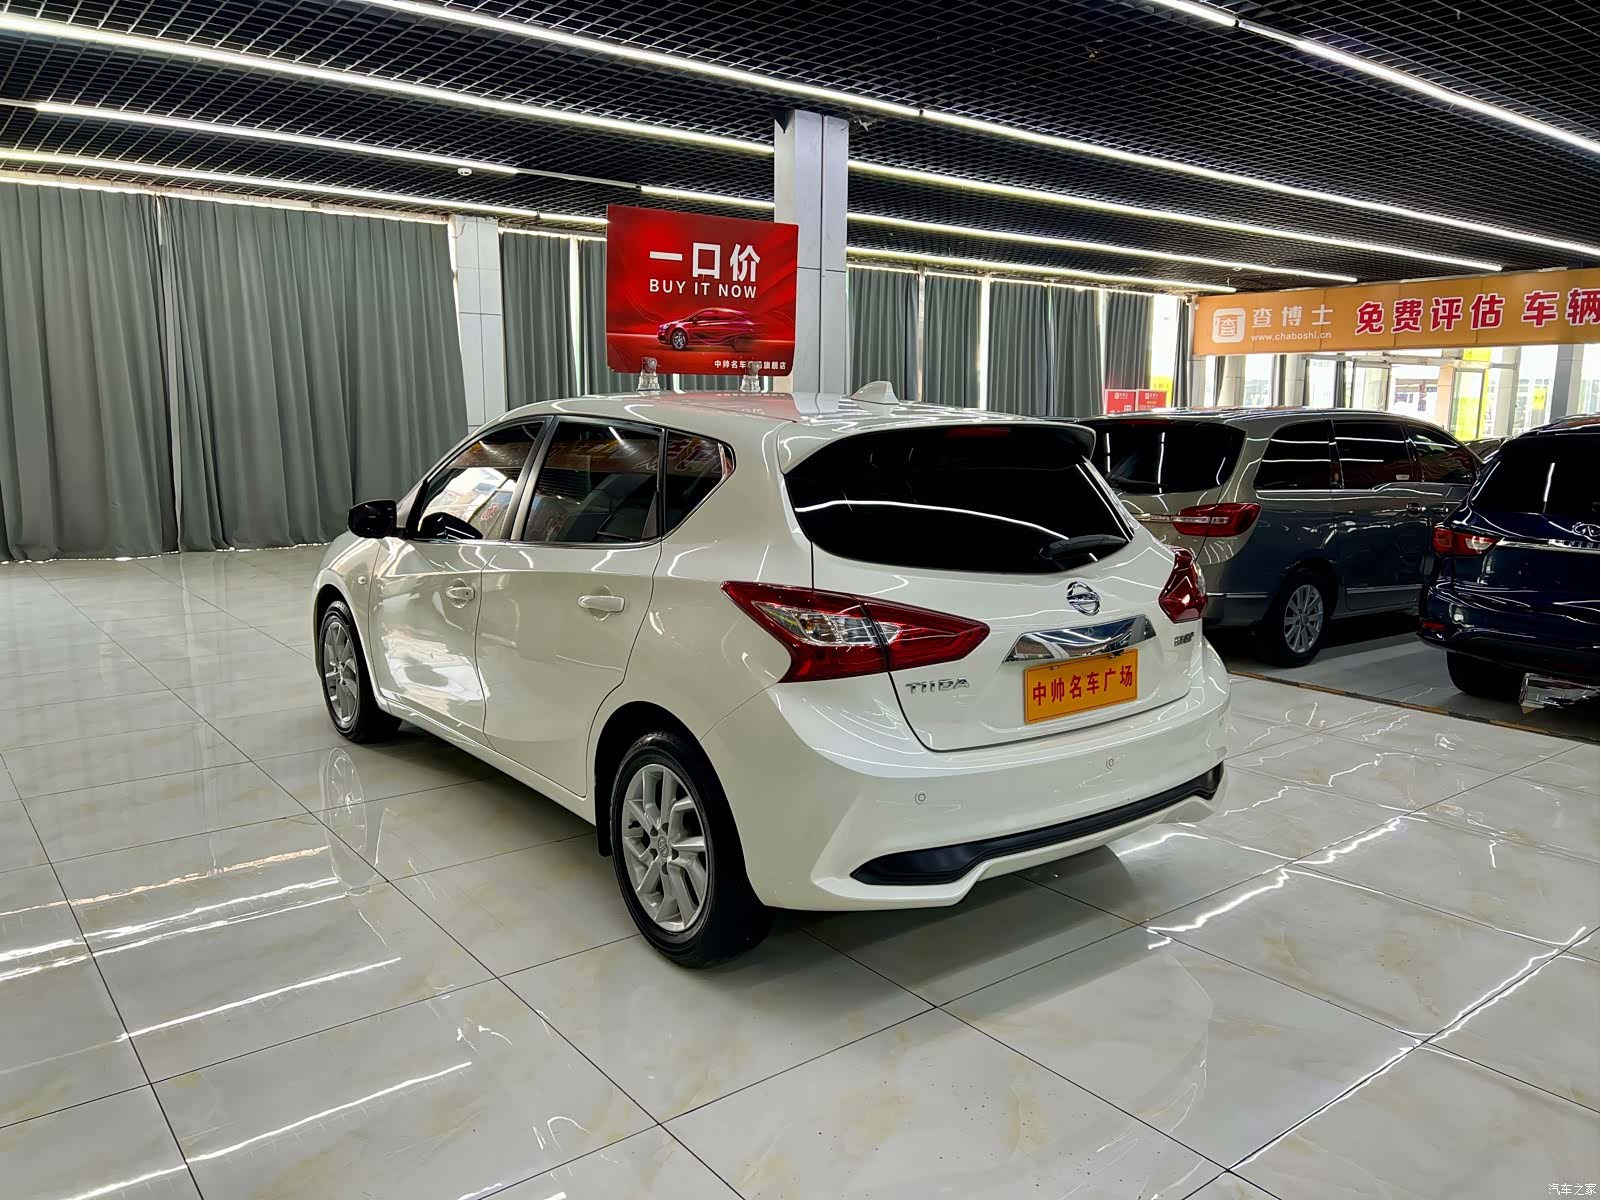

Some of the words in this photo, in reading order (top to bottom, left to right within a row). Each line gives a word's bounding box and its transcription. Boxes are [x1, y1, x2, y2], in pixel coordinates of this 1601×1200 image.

[650, 242, 761, 283] 一口价
[650, 278, 686, 295] BUY
[694, 281, 710, 296] IT
[718, 284, 757, 299] NOW
[1251, 304, 1334, 329] 查博士
[1355, 293, 1505, 335] 免费评估
[1250, 330, 1332, 341] www.chaboshi.cn
[905, 676, 970, 695] TIIDA
[1032, 664, 1133, 707] 中帅名车广场
